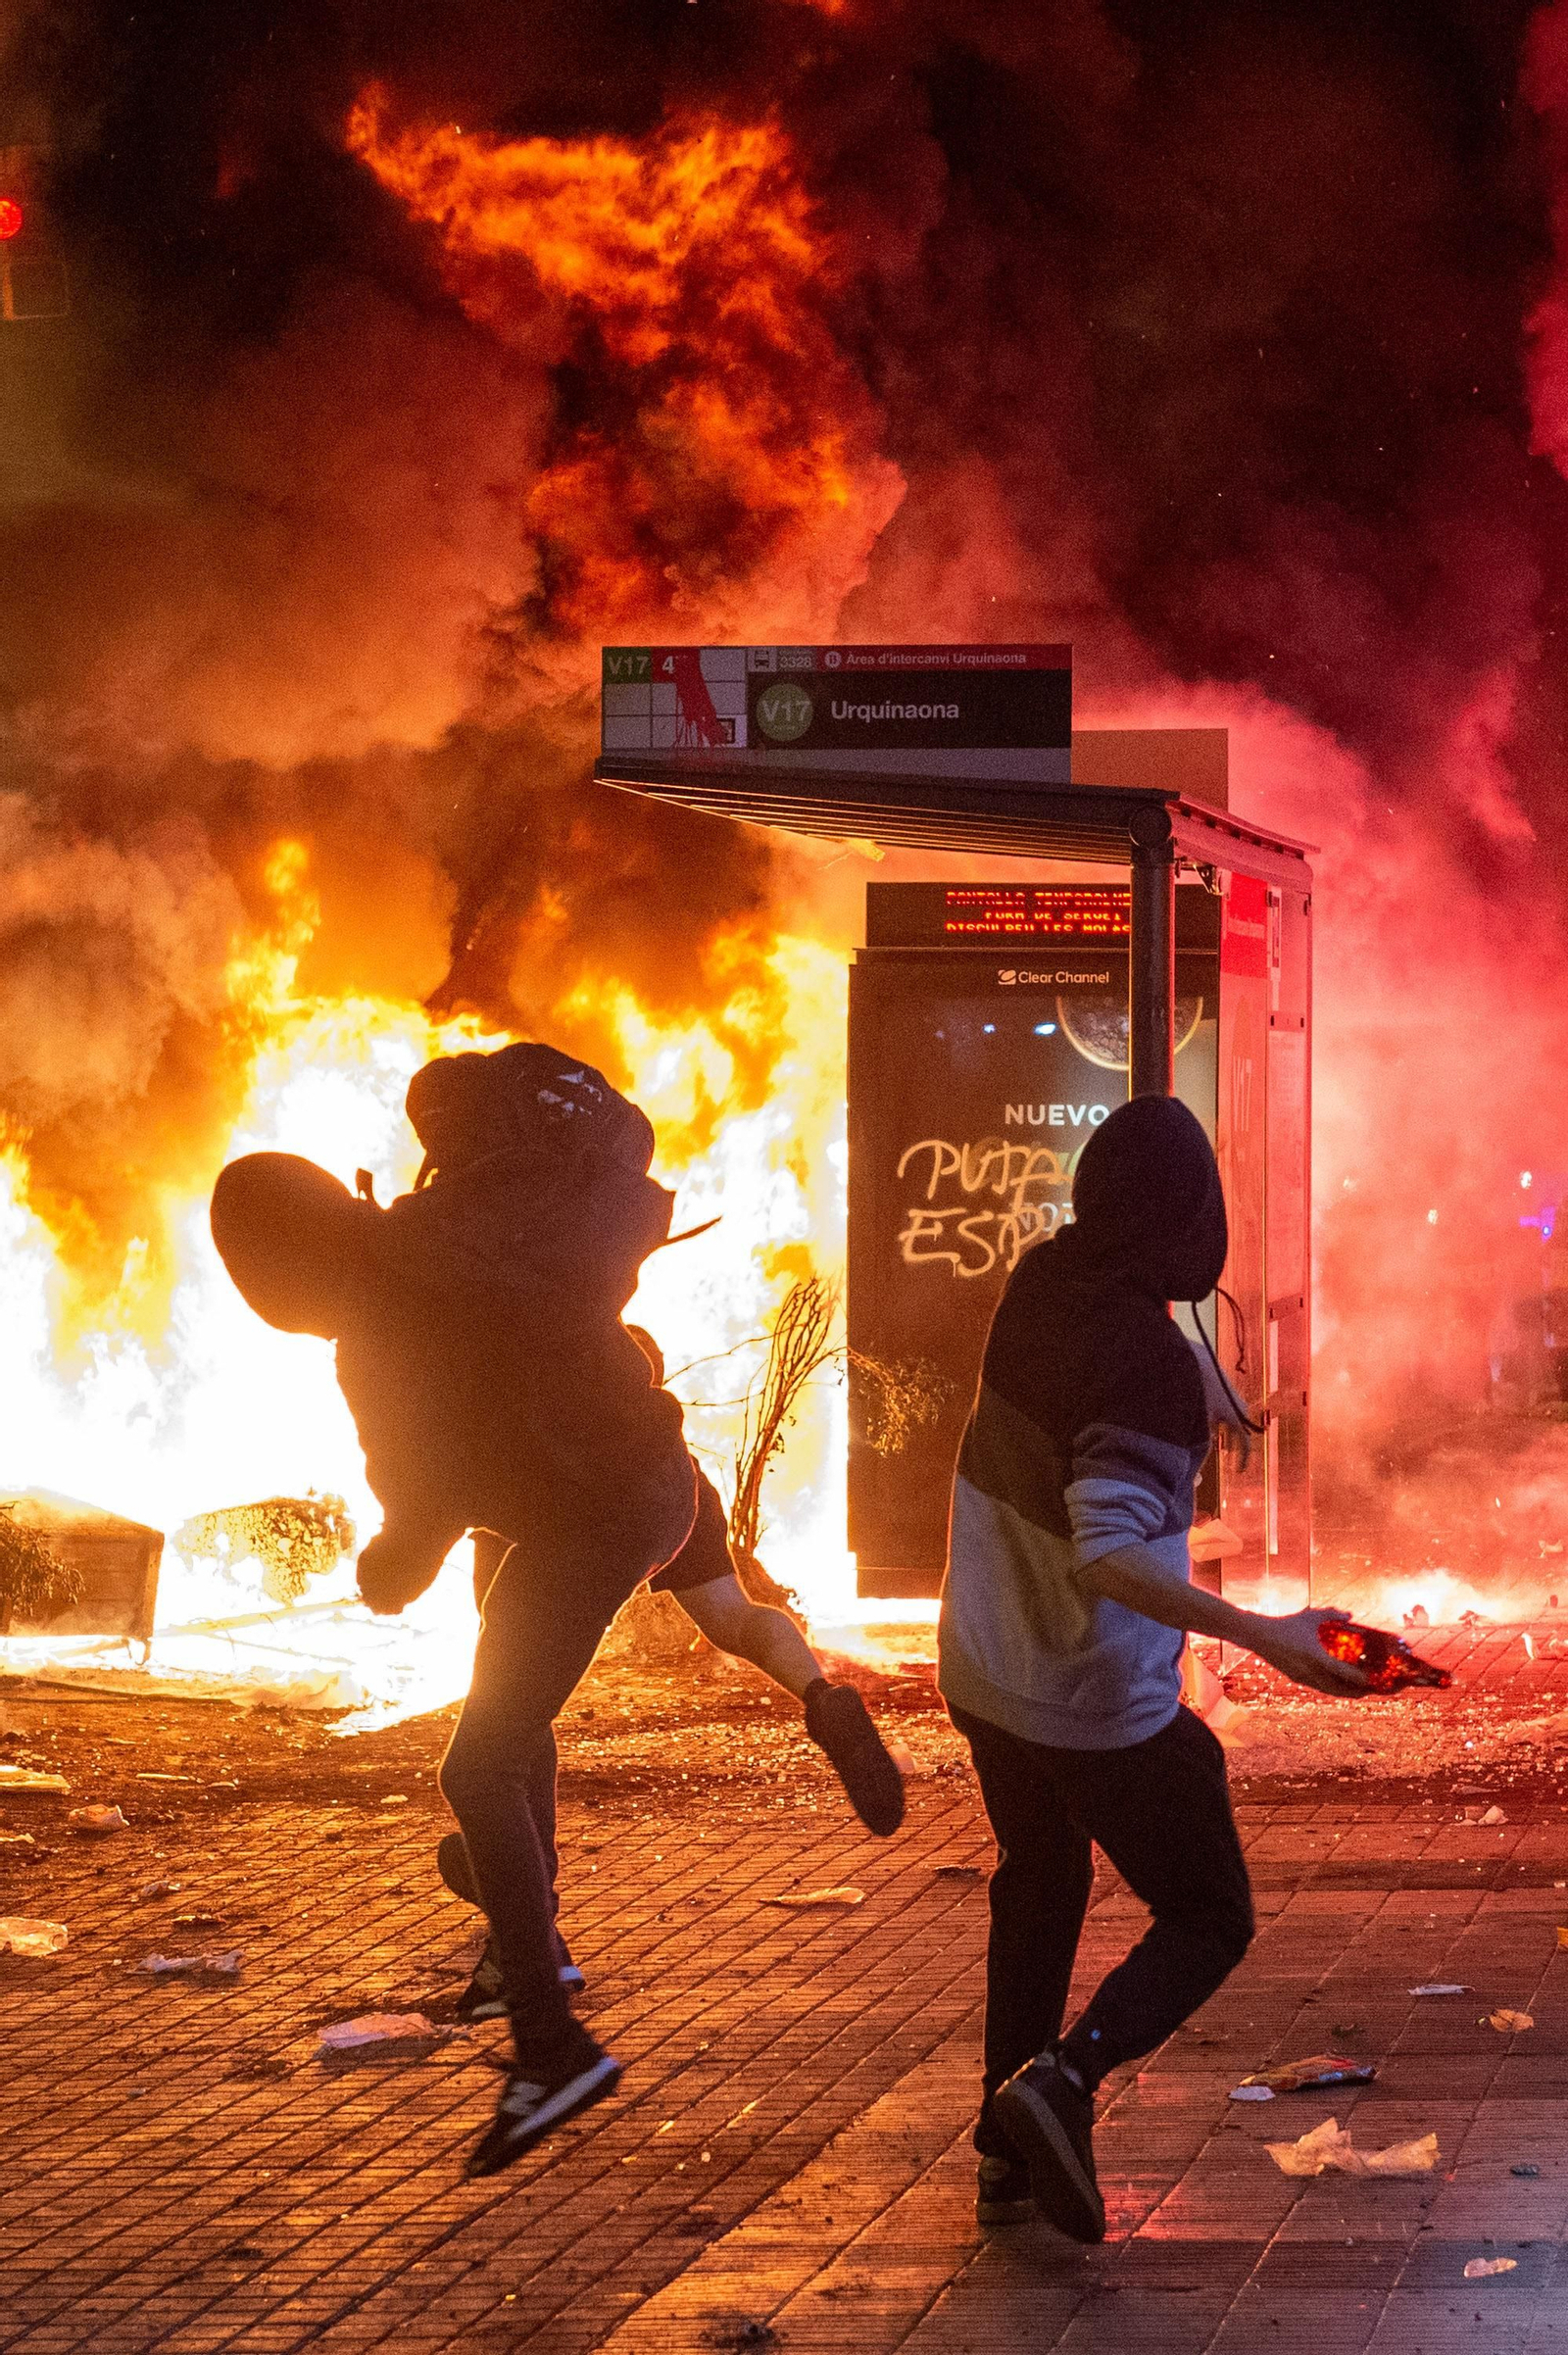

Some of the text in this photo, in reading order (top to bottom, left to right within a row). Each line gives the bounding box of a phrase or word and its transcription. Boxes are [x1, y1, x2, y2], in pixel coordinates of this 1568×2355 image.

[608, 656, 649, 675] V17
[881, 651, 950, 665] d'intercanvi
[953, 651, 1026, 666] Urquinaona
[761, 700, 811, 722] V17
[831, 699, 959, 722] Urquinaona
[1017, 970, 1109, 984] Clear Channel
[1004, 1104, 1110, 1126] NUEVO
[897, 1139, 1074, 1201] PUTA
[898, 1205, 1062, 1277] ESP
